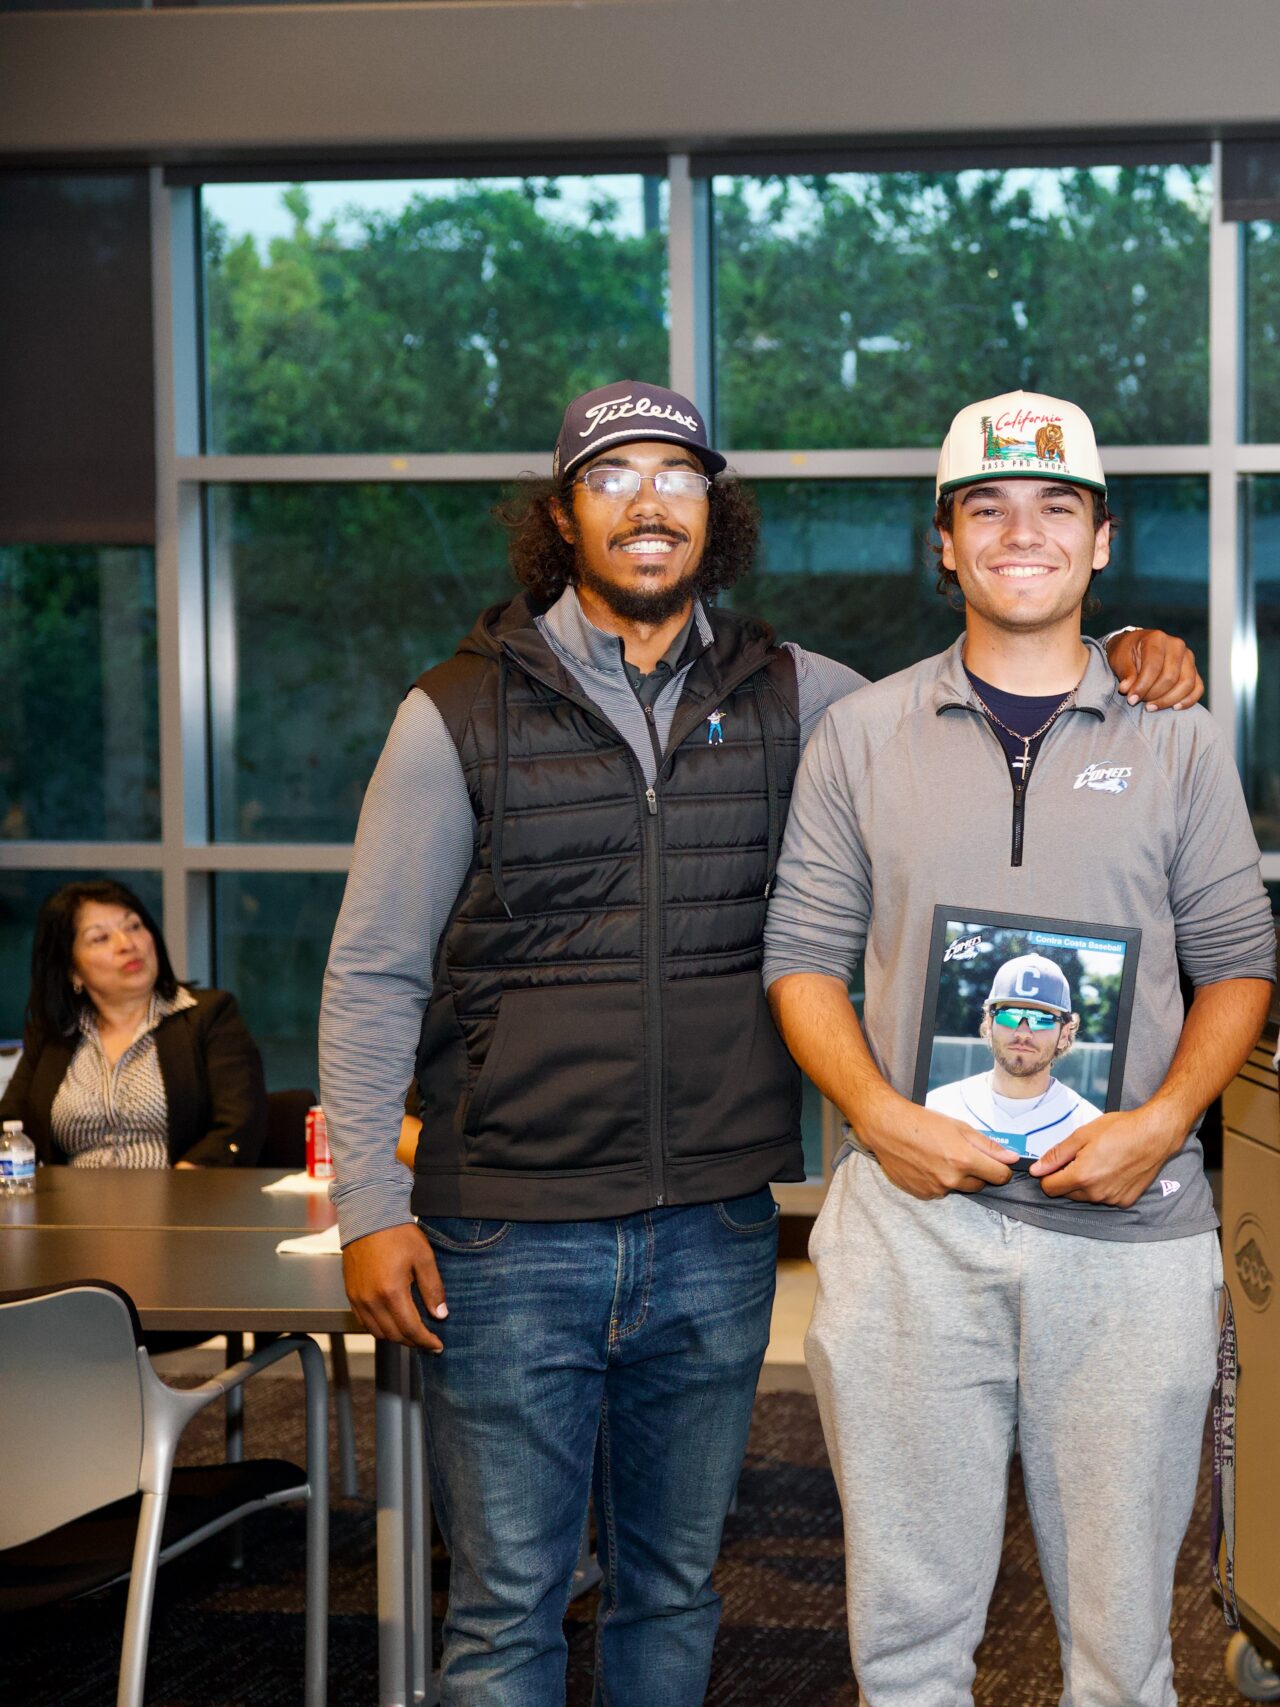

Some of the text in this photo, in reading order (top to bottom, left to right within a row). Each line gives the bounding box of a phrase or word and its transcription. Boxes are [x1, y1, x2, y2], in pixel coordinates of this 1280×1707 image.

[579, 395, 698, 438] Titleist
[995, 409, 1064, 432] California
[982, 460, 1067, 473] BASS PRO SHOPS
[1035, 935, 1122, 953] Contra Costa Baseball
[1015, 966, 1041, 997] C
